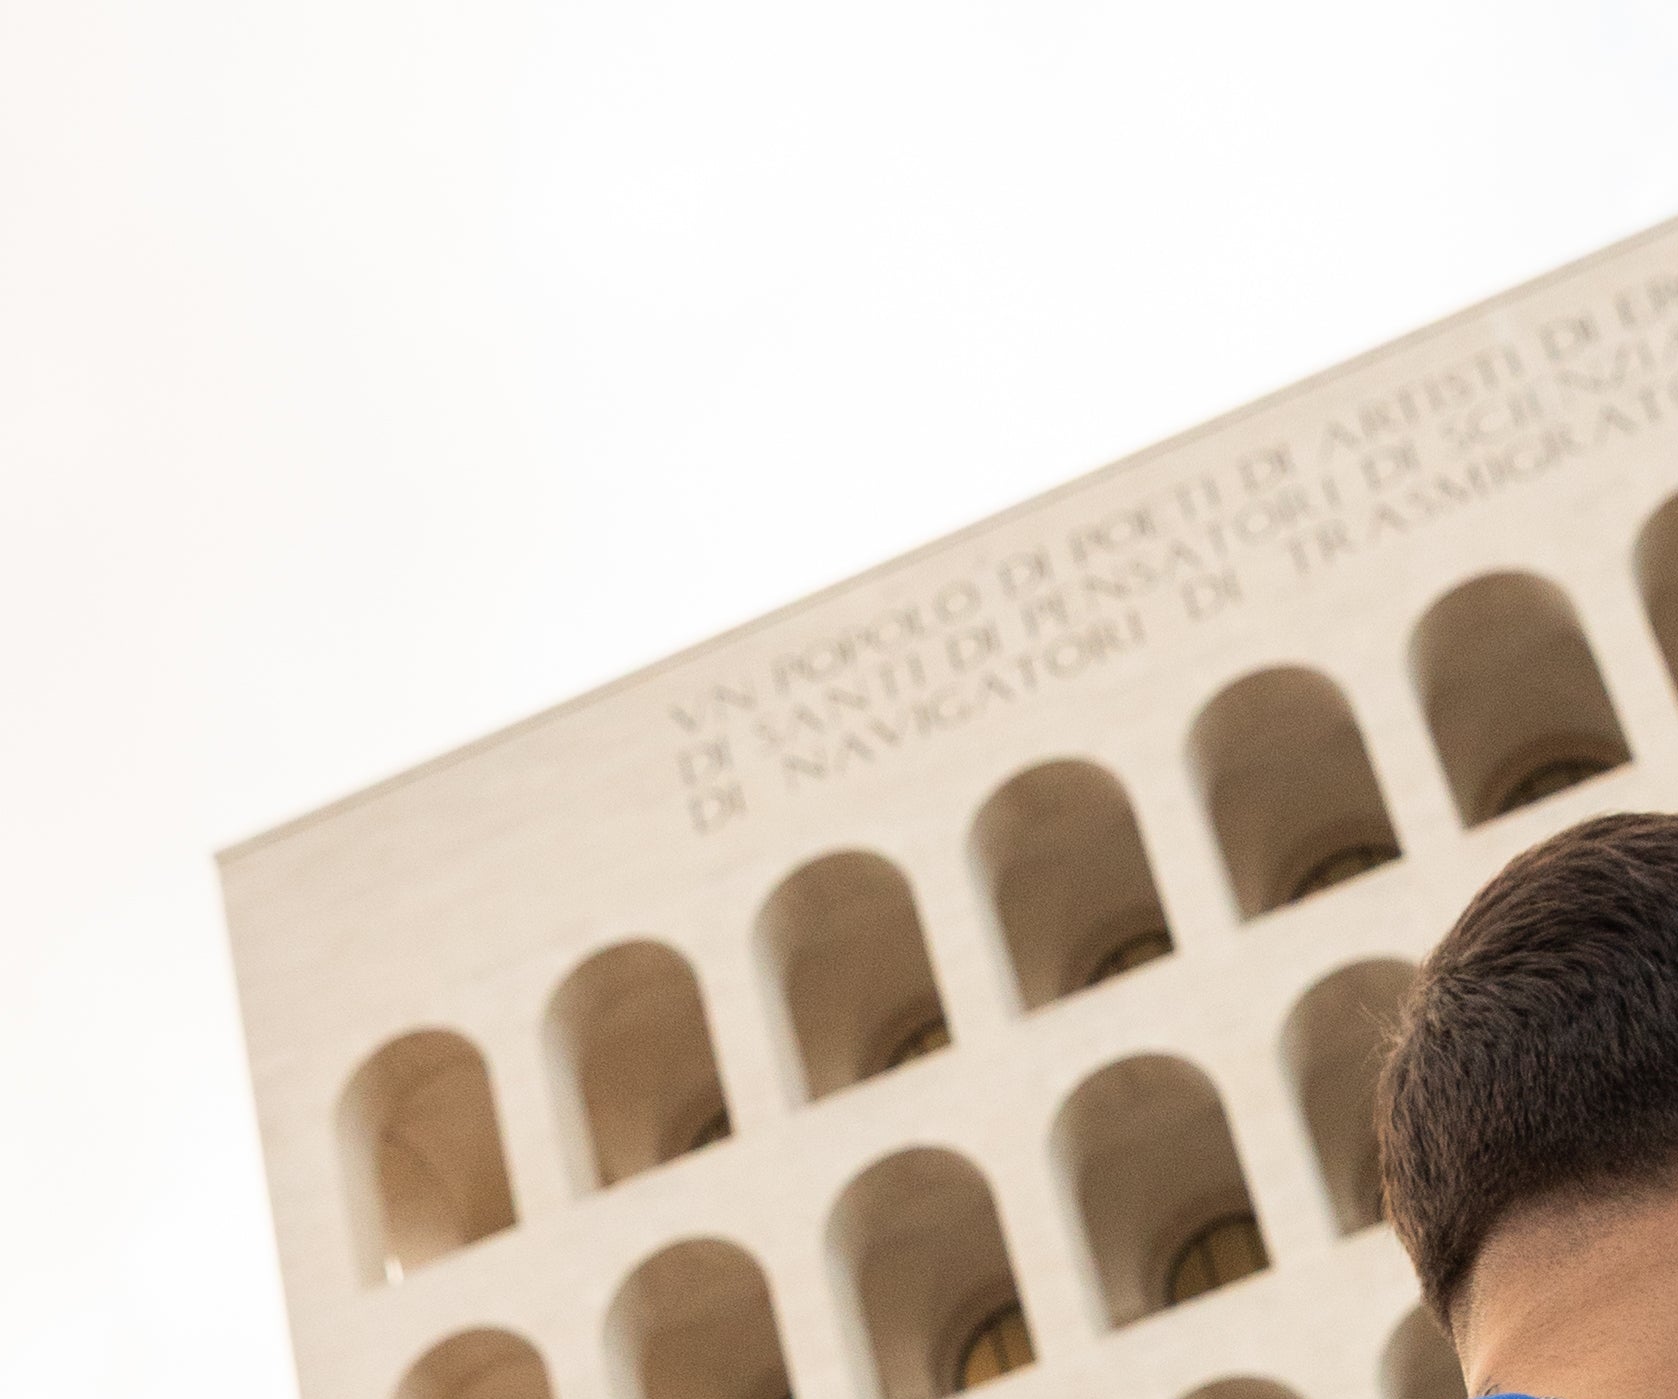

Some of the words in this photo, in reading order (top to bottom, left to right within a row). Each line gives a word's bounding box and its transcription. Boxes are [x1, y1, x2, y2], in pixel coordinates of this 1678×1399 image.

[945, 618, 1003, 675] DI
[1359, 438, 1421, 493] DI
[998, 543, 1054, 598] DI
[1236, 437, 1294, 493] DI
[1538, 310, 1600, 363] DI
[782, 605, 1146, 795] NAVIGATORI
[1181, 567, 1243, 623] DI
